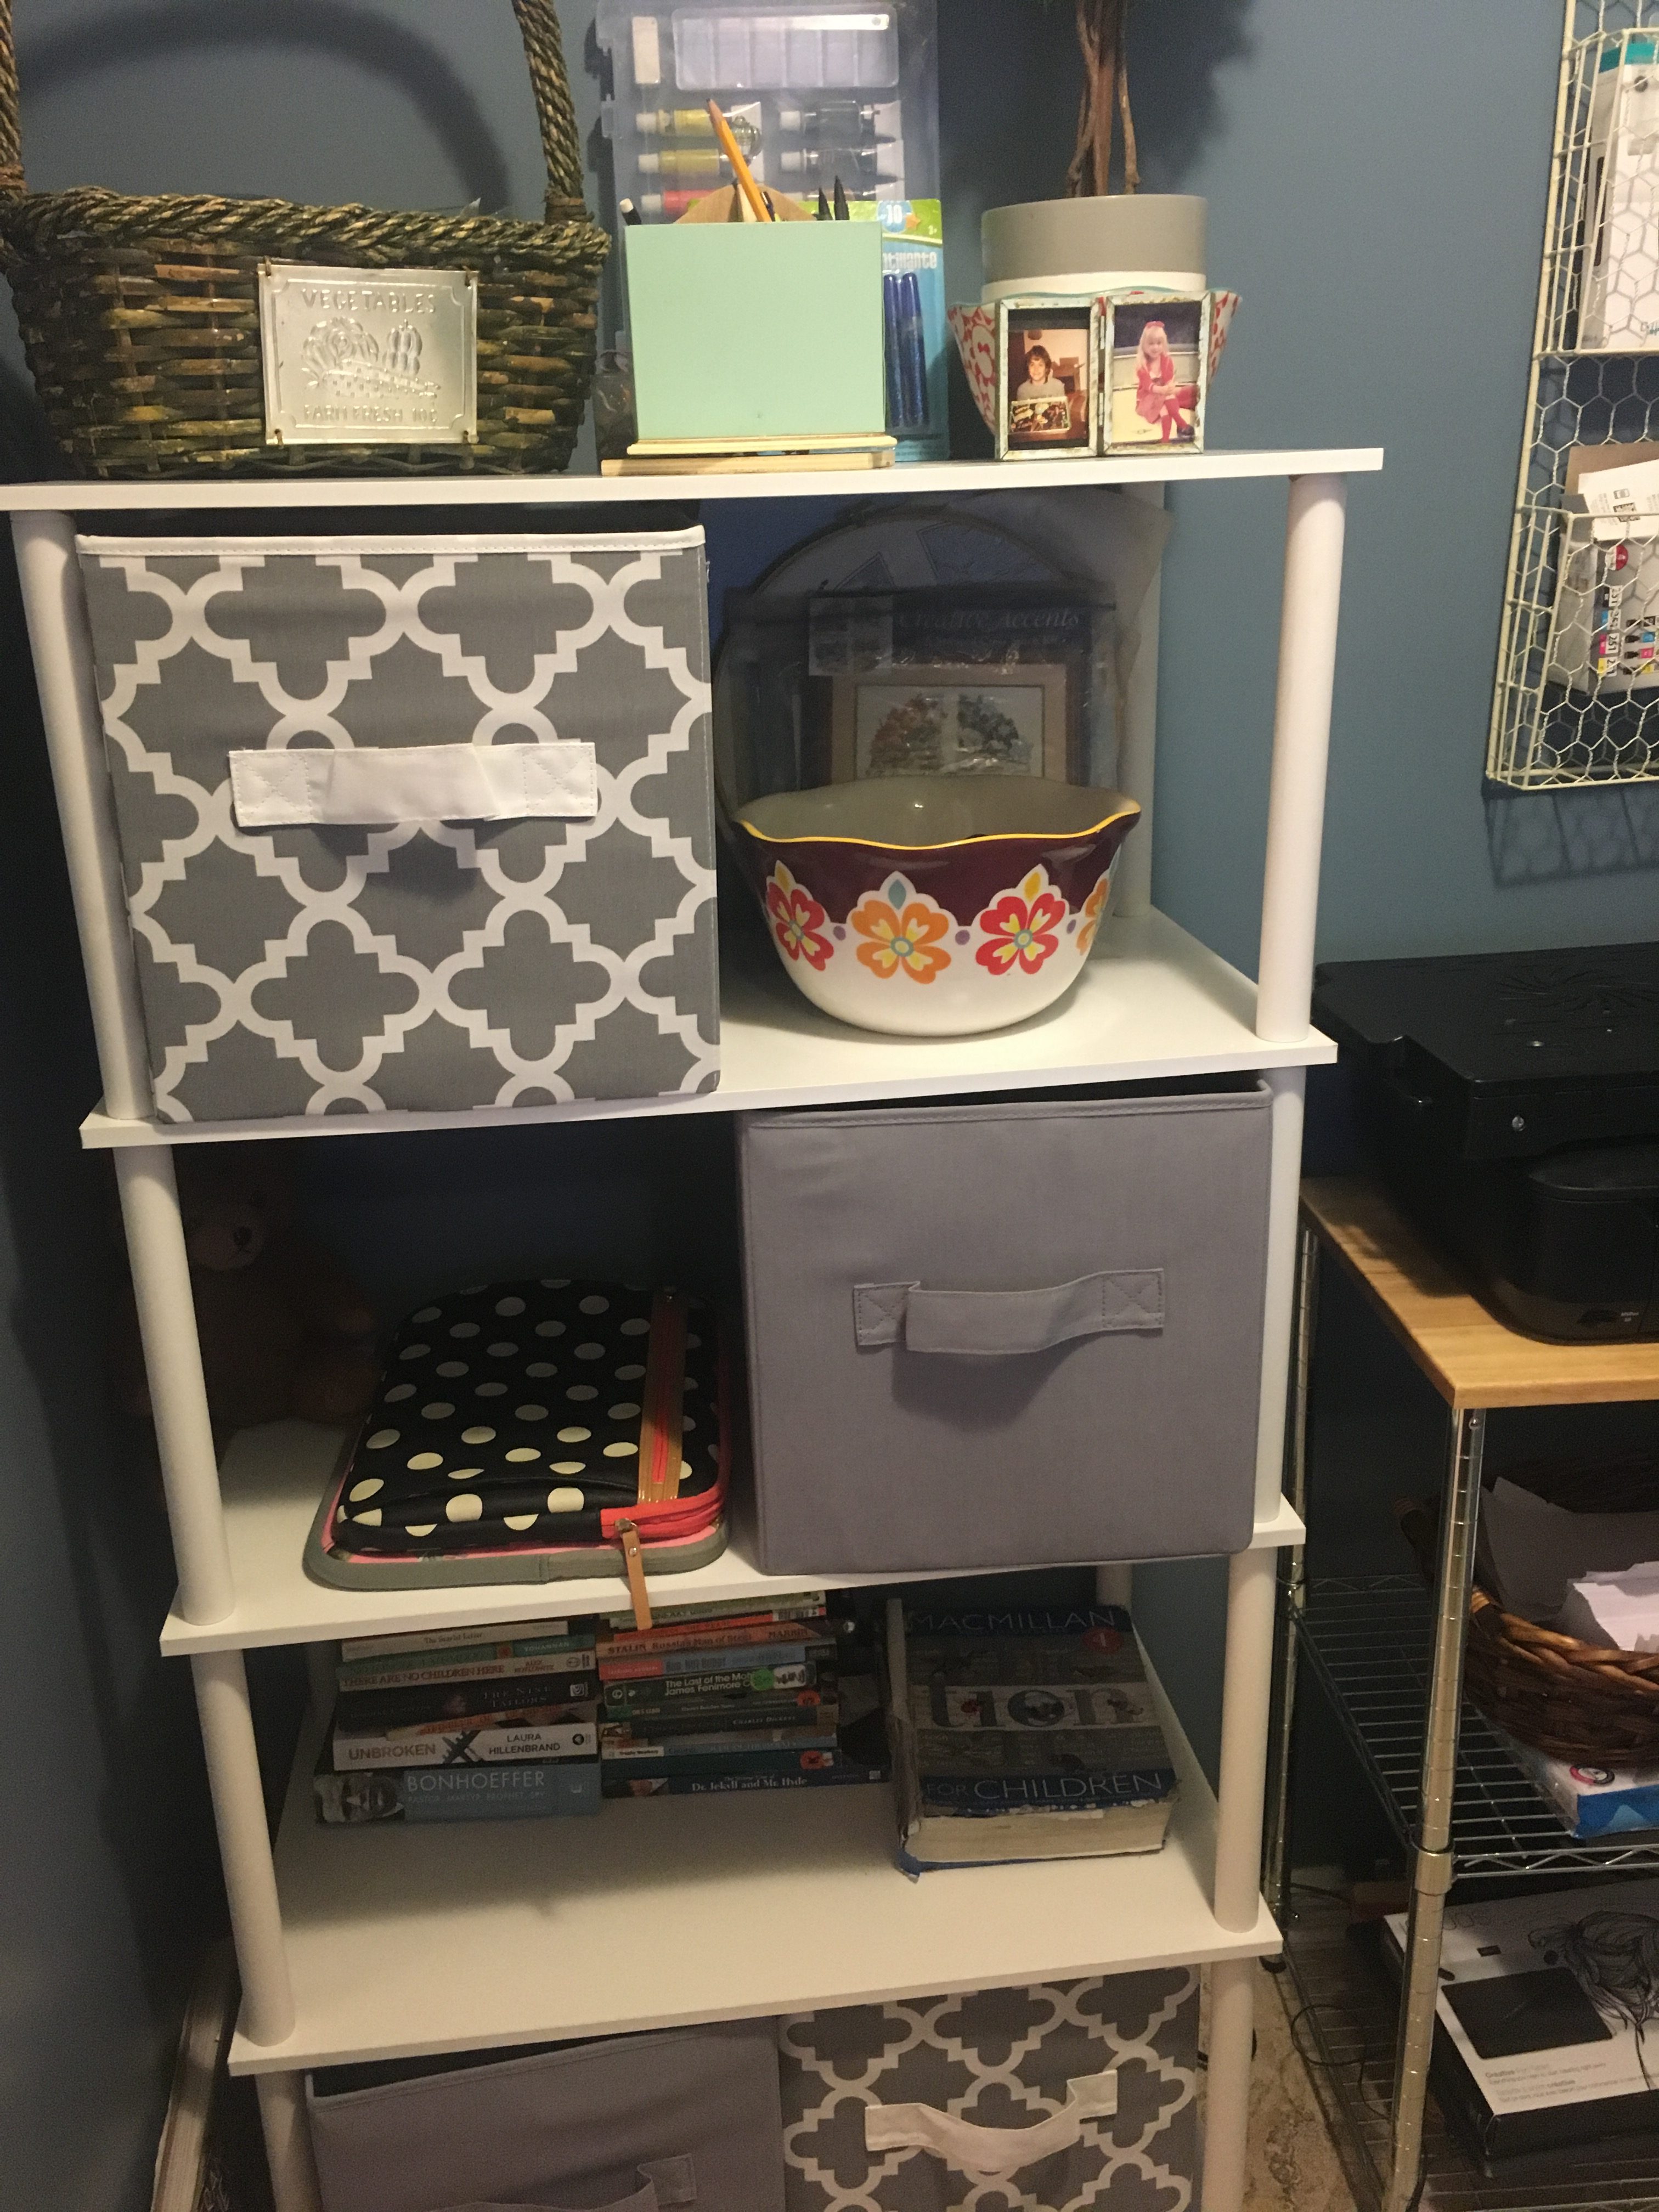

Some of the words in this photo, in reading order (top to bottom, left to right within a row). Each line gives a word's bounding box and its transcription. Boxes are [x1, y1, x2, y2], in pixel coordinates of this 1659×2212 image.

[886, 204, 903, 226] 10
[301, 289, 437, 313] VEGETABLES
[303, 404, 348, 421] FARM
[353, 405, 403, 422] FRESH
[995, 607, 1079, 629] Accents
[1607, 635, 1617, 651] 251
[911, 1610, 1117, 1630] MACMILLAN
[608, 1644, 646, 1655] STALIN
[343, 1675, 377, 1686] THERE
[379, 1674, 400, 1684] ARE
[403, 1672, 419, 1681] NO
[420, 1667, 475, 1680] CHILDREN
[476, 1664, 505, 1675] HERE
[665, 1680, 682, 1689] The
[684, 1677, 702, 1686] Last
[703, 1675, 713, 1684] of
[714, 1674, 730, 1683] the
[664, 1687, 695, 1696] James
[697, 1681, 741, 1693] Fenimore
[506, 1733, 543, 1743] LAURA
[348, 1743, 437, 1760] UNBROKEN
[488, 1742, 561, 1755] HILLENBRAND
[408, 1771, 545, 1792] BONHOEFFER
[709, 1781, 738, 1791] Jekyll
[741, 1779, 760, 1788] and
[781, 1776, 808, 1786] Hyde
[927, 1782, 967, 1797] FOR
[974, 1773, 1162, 1800] CHILDREN
